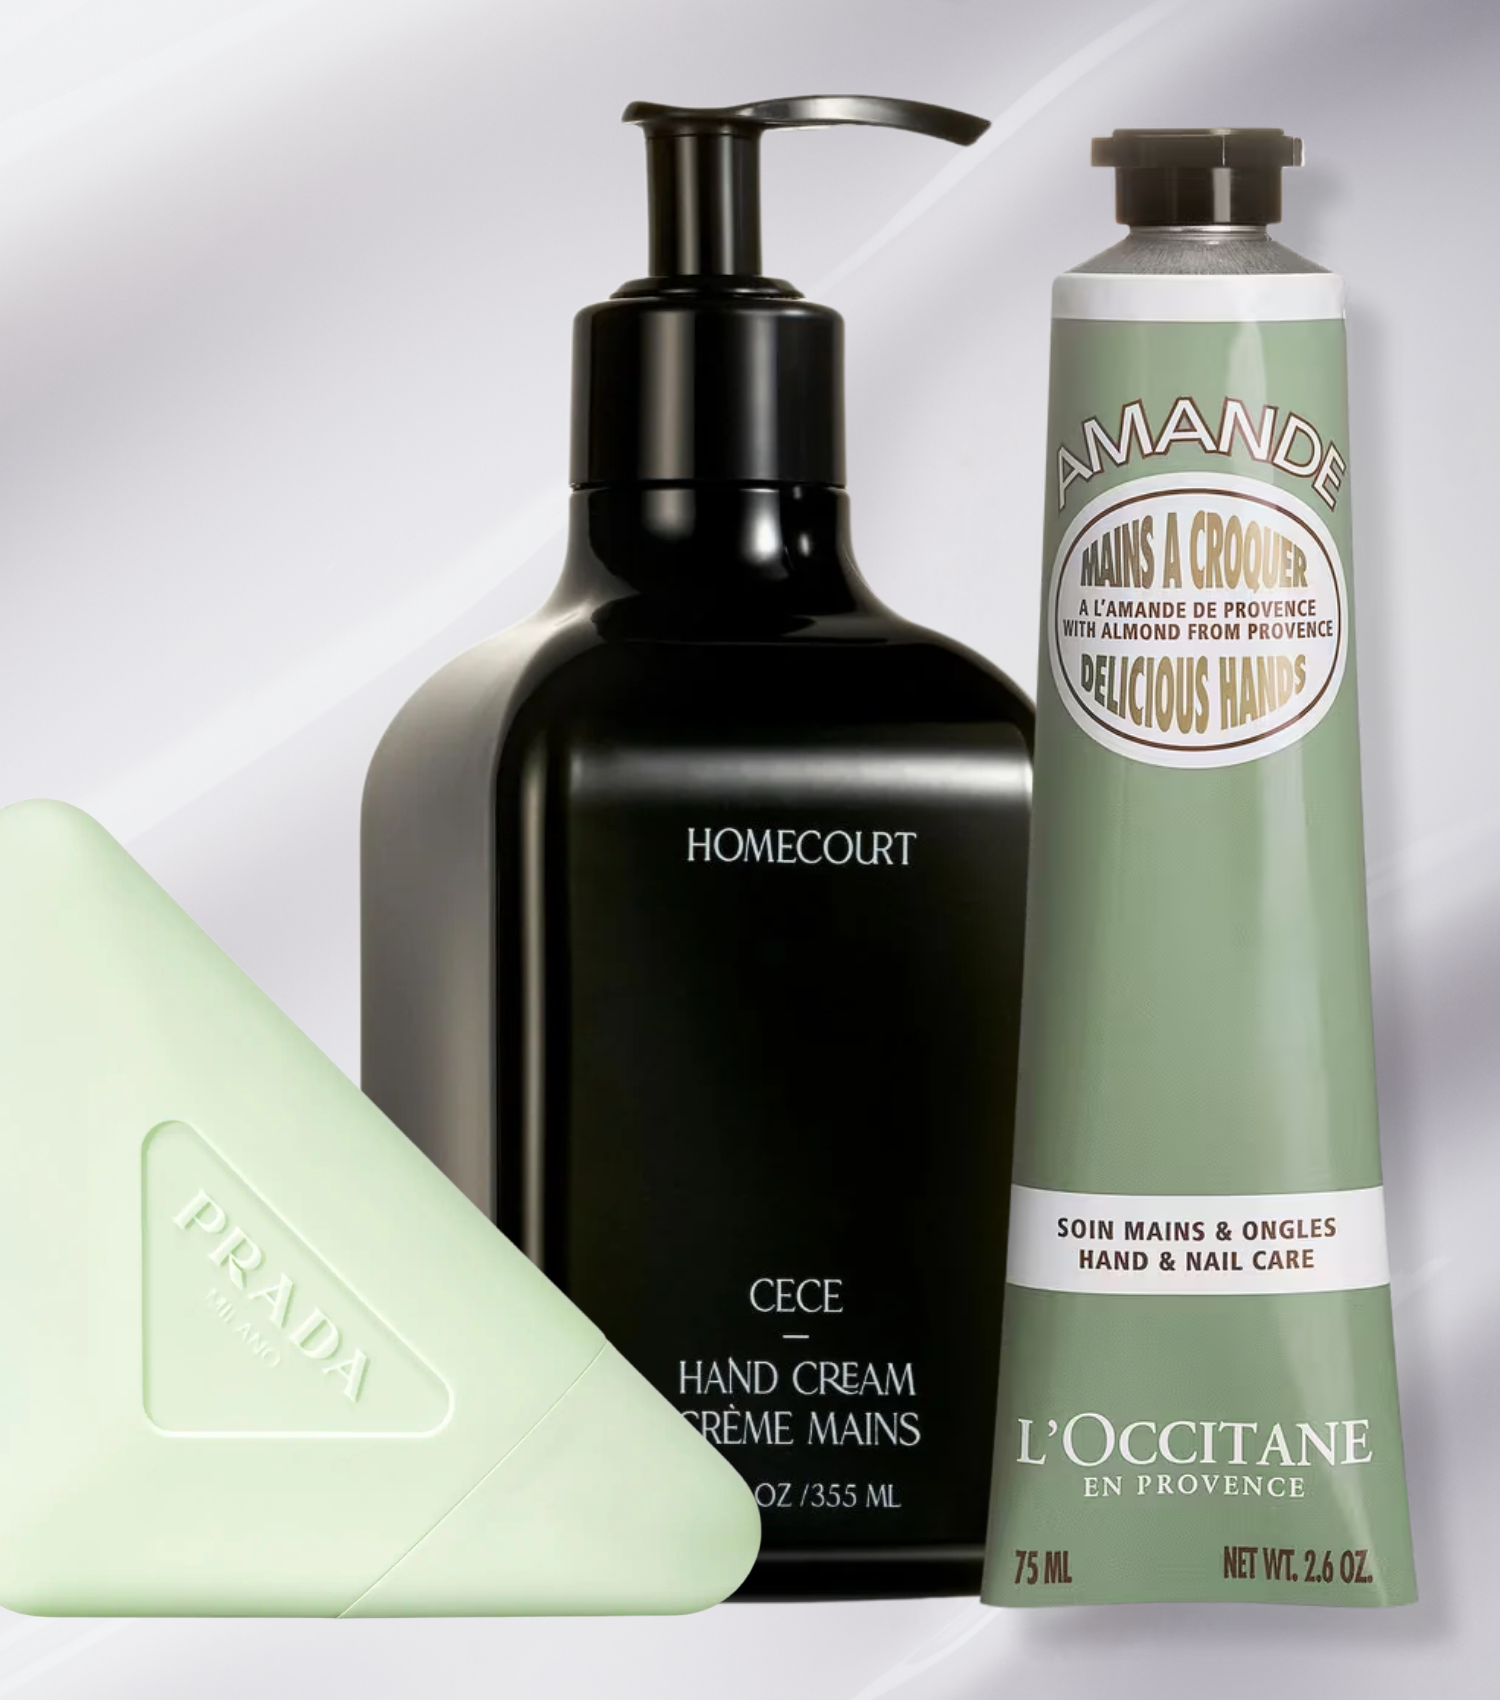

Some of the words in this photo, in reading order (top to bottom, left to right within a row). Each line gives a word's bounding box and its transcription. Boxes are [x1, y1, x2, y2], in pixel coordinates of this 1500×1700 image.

[1056, 396, 1347, 512] AMANDE
[1080, 515, 1155, 590] MAINS
[1162, 512, 1183, 589] A
[1189, 510, 1308, 594] CROQUER
[1078, 599, 1089, 616] A
[1094, 599, 1187, 619] L'AMANDE
[1193, 601, 1218, 619] DE
[1223, 599, 1317, 619] PROVENCE
[1063, 619, 1097, 638] WITH
[1101, 622, 1181, 641] ALMOND
[1187, 623, 1242, 641] FROM
[1247, 619, 1334, 641] PROVENCE
[1080, 653, 1210, 735] DELICIOUS
[1218, 653, 1307, 731] HANDS
[687, 827, 917, 866] HOMECOURT
[1057, 1218, 1114, 1240] SOIN
[1124, 1221, 1206, 1241] MAINS
[1215, 1221, 1233, 1242] &
[1242, 1217, 1338, 1240] ONGLES
[1079, 1249, 1149, 1271] HAND
[1158, 1251, 1177, 1271] &
[1185, 1251, 1244, 1272] NAIL
[1252, 1249, 1316, 1271] CARE
[171, 1187, 373, 1403] PRADA
[749, 1277, 844, 1313] CECE
[202, 1287, 282, 1369] MILANO
[678, 1357, 779, 1395] HAND
[792, 1361, 917, 1396] CREAM
[807, 1411, 921, 1446] MAINS
[754, 1482, 792, 1508] OZ
[865, 1484, 902, 1508] ML
[1083, 1476, 1123, 1498] EN
[1137, 1474, 1306, 1498] PROVENCE
[1014, 1550, 1039, 1585] 75
[1044, 1551, 1073, 1585] ML
[1223, 1545, 1259, 1581] NET
[1262, 1548, 1299, 1583] WT.
[1303, 1550, 1333, 1584] 2.6
[1339, 1551, 1374, 1585] OZ.
